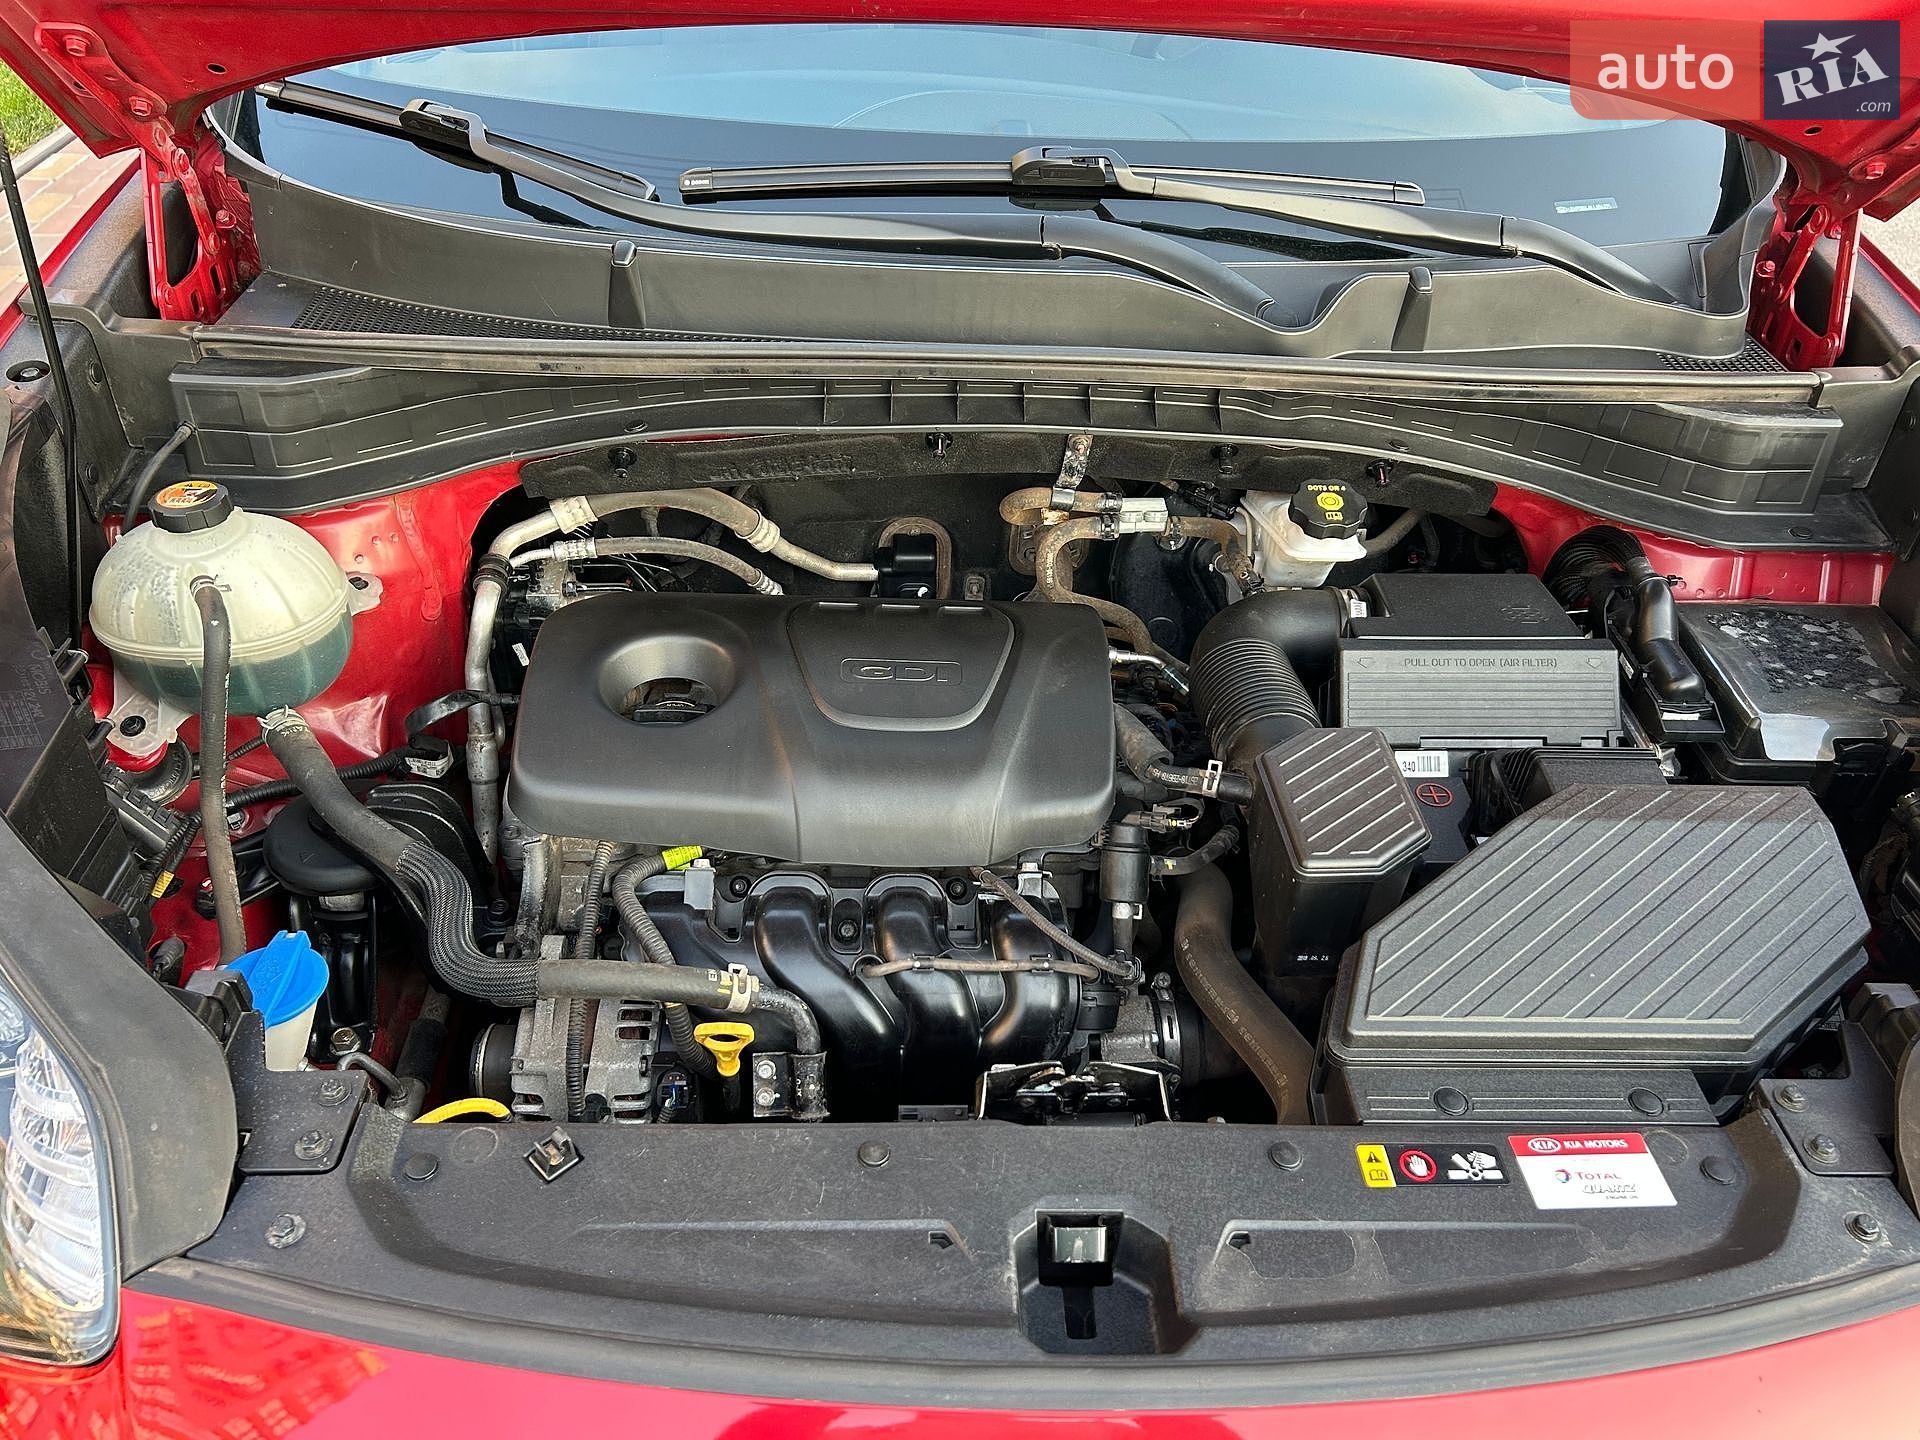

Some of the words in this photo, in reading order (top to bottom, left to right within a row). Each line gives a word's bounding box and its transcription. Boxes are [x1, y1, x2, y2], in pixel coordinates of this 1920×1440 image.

[1404, 658, 1430, 667] PULL
[1431, 658, 1451, 667] OUT
[1454, 658, 1467, 667] TO
[1469, 658, 1496, 667] OPEN
[1499, 658, 1520, 668] (AIR
[1522, 658, 1558, 668] FILTER)
[851, 665, 948, 682] GDI
[1402, 761, 1416, 772] 340
[1532, 1141, 1557, 1150] KIA
[1563, 1141, 1583, 1149] KIA
[1583, 1140, 1628, 1148] MOTORS
[1576, 1172, 1622, 1180] TOTAL
